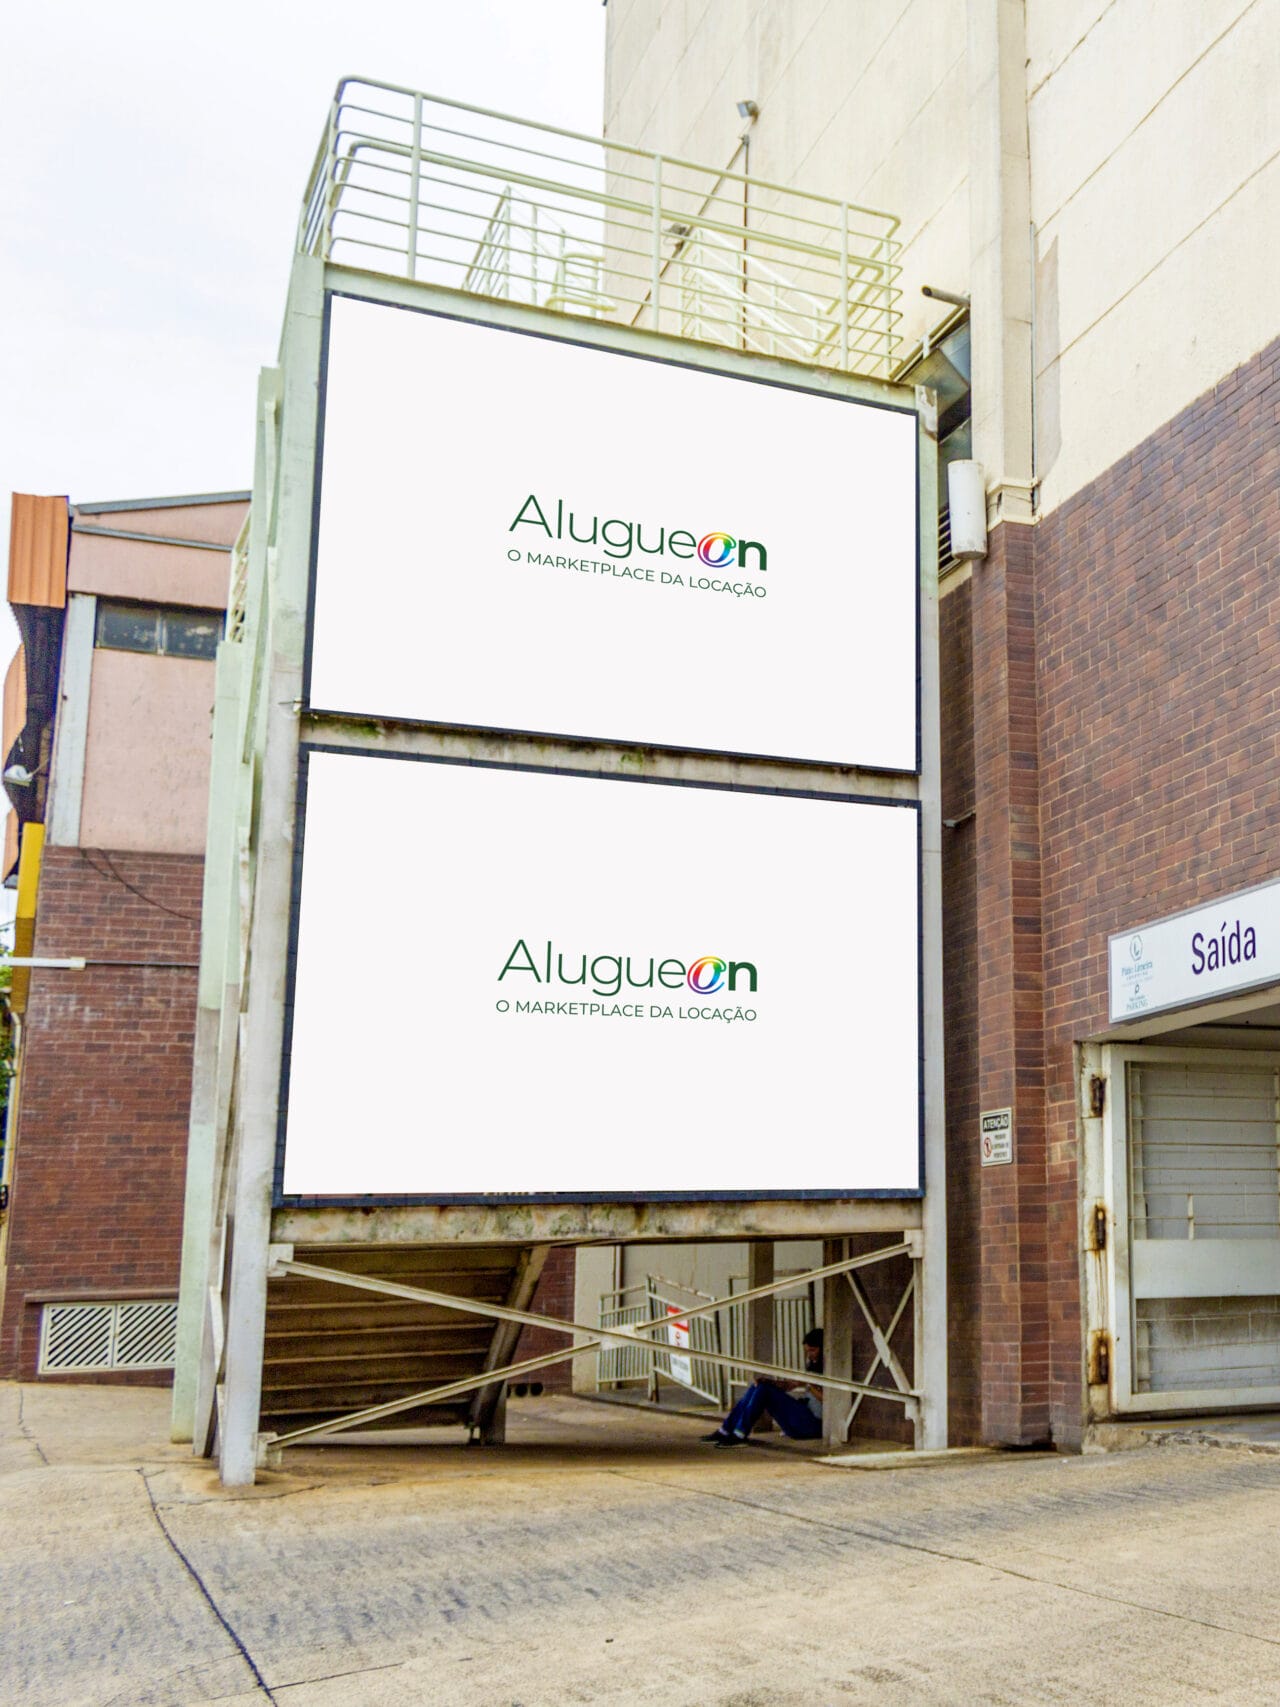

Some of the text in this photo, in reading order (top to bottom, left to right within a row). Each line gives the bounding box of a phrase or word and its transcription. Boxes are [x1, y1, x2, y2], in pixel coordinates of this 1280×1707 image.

[507, 549, 767, 598] O MARKETPLACE DA LOCAÇÃO
[1191, 920, 1257, 975] Saída
[496, 1000, 757, 1024] O MARKETPLACE DA LOCAÇÃO
